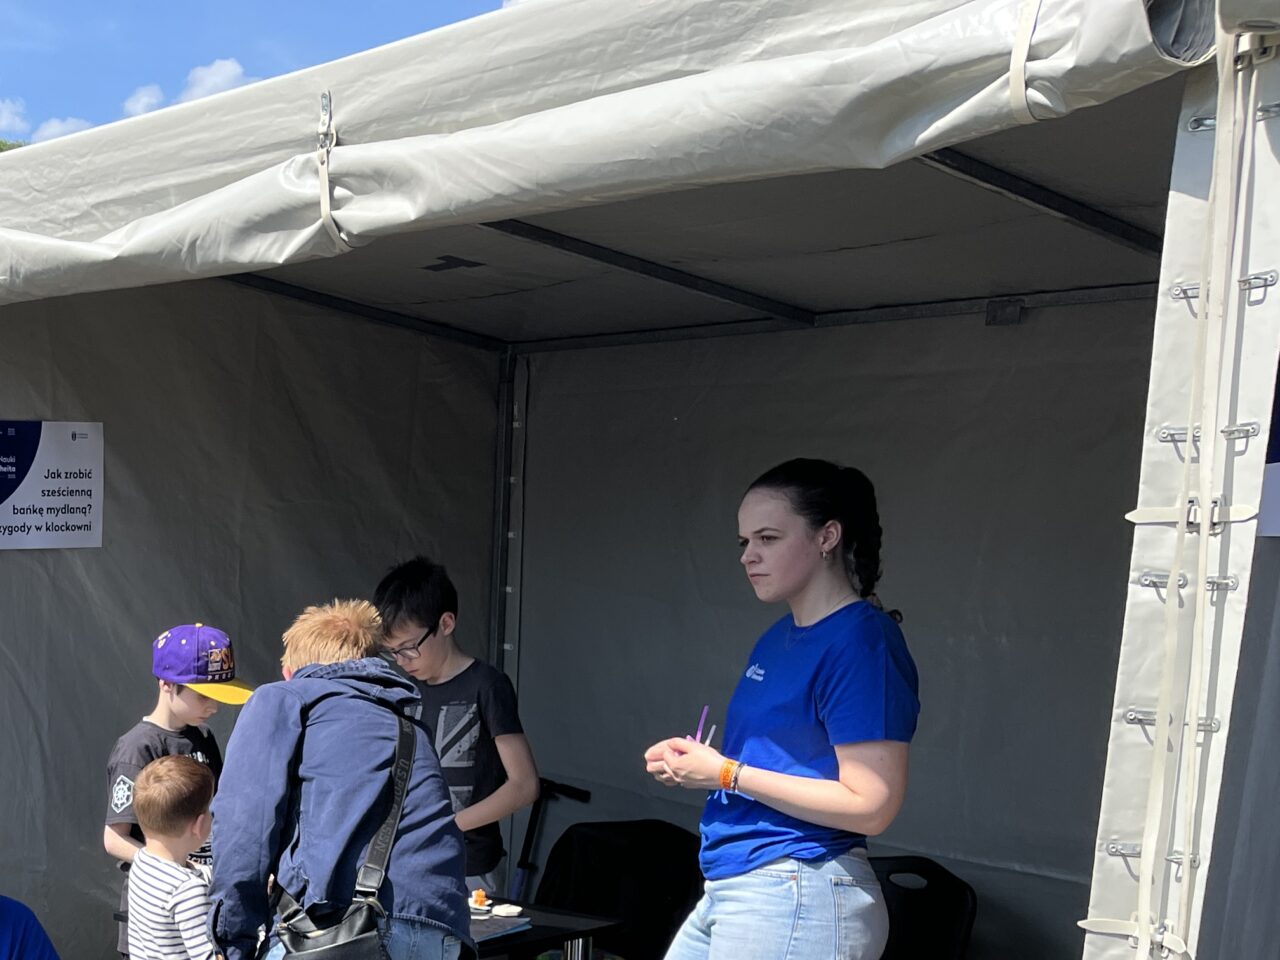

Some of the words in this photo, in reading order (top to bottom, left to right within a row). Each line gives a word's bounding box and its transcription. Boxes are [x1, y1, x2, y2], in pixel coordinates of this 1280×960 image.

[44, 468, 62, 479] Jak
[64, 468, 92, 479] zrobić
[41, 486, 92, 499] sześcienną
[12, 504, 44, 517] bańkę
[46, 504, 92, 517] mydlaną?
[45, 521, 92, 532] klockowni
